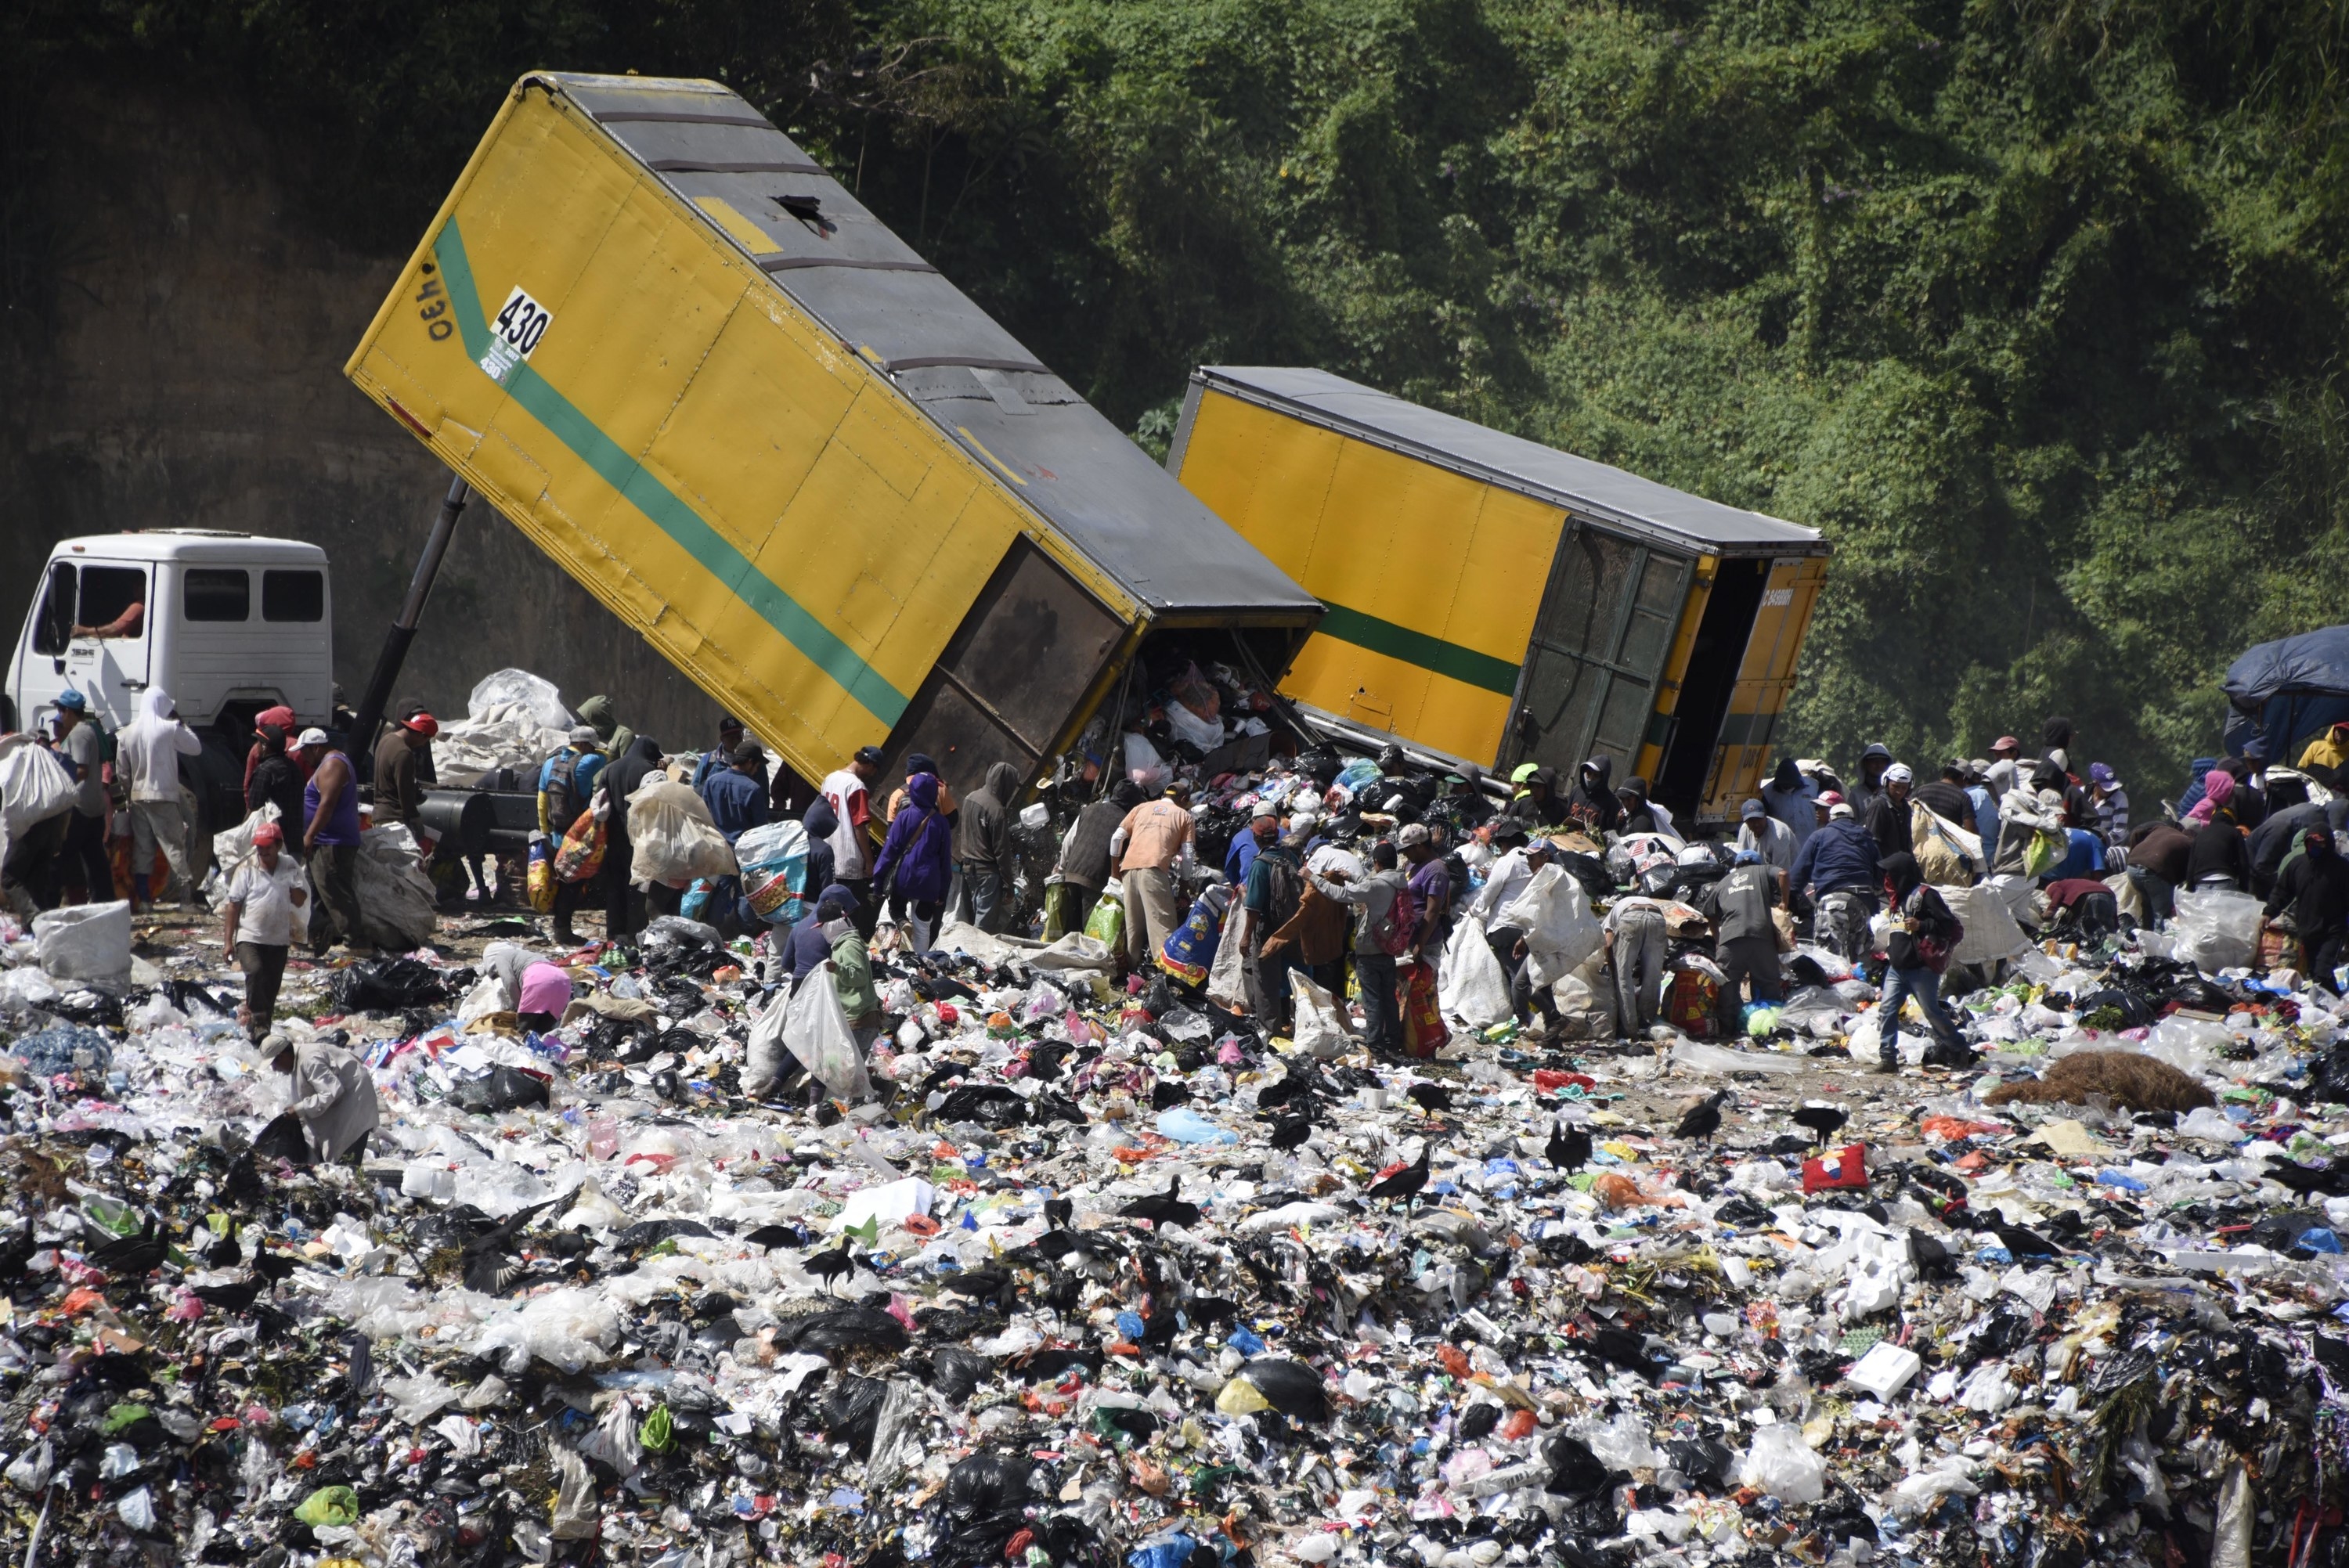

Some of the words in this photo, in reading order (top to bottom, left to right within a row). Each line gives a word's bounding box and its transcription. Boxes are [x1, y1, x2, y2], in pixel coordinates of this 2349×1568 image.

[416, 279, 453, 341] 430
[497, 294, 548, 355] 430
[480, 357, 501, 380] 430
[1763, 589, 1770, 607] C
